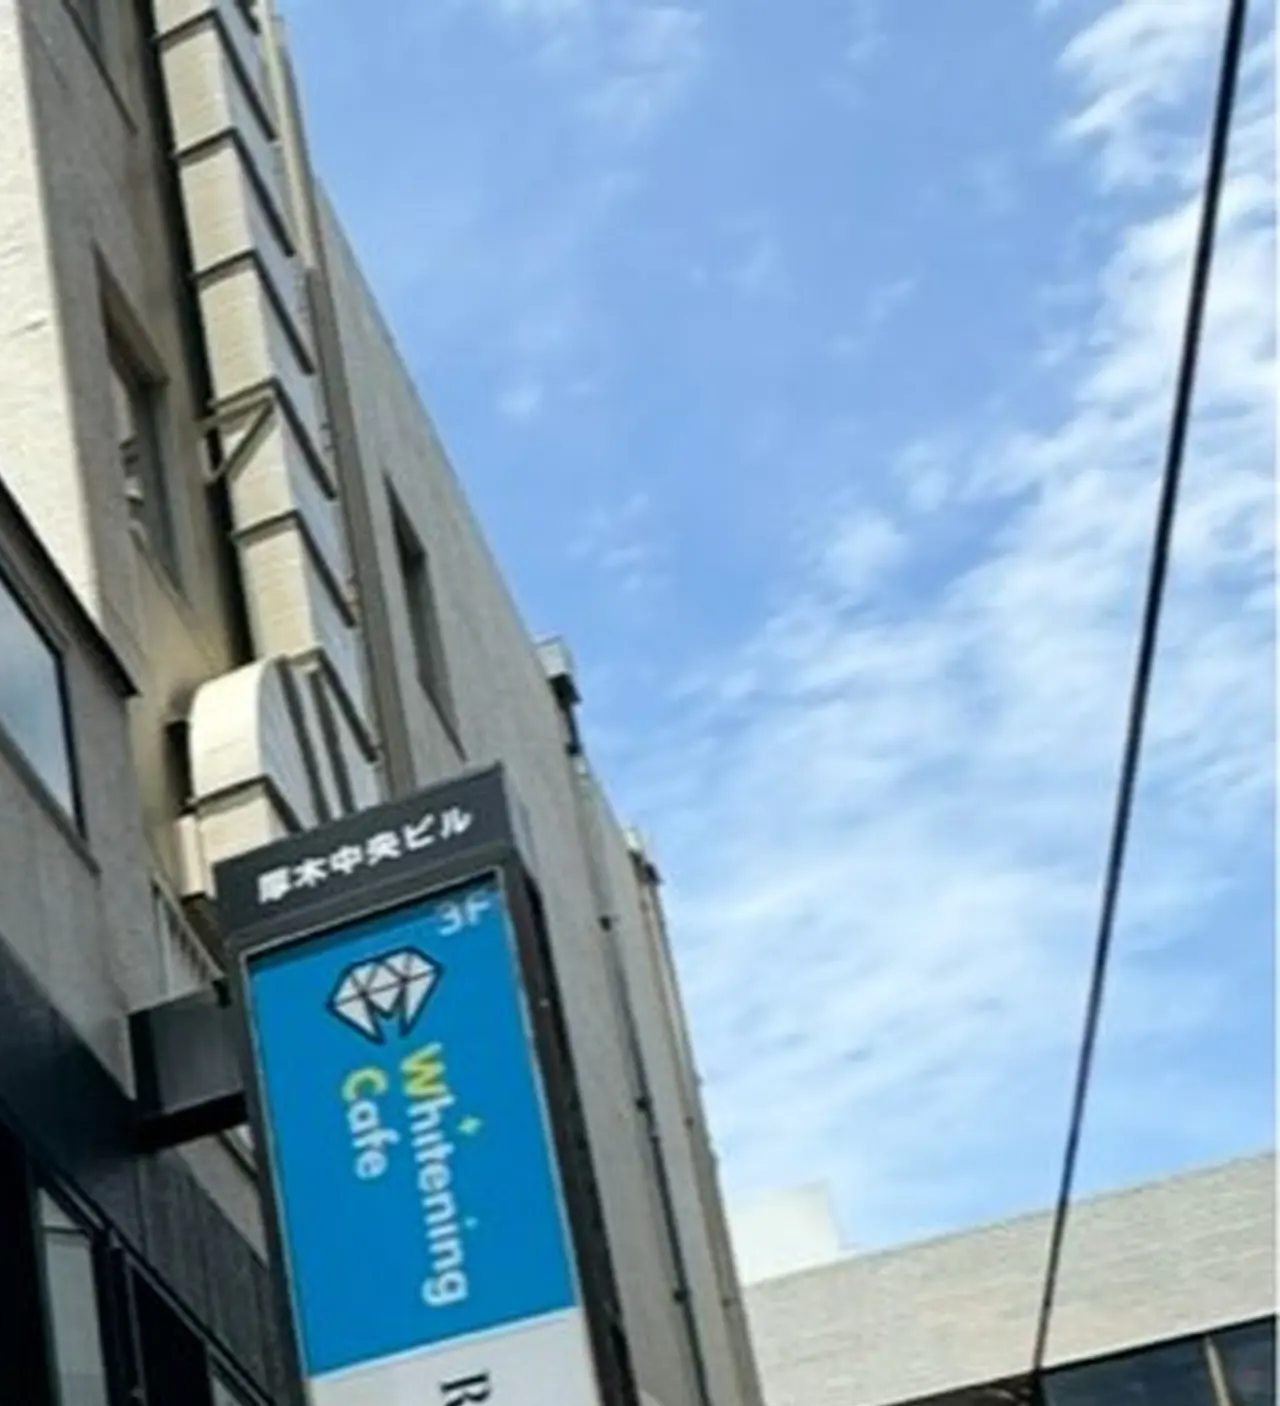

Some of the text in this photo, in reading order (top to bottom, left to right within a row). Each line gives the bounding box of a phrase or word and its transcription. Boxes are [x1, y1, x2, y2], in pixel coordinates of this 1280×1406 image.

[256, 806, 474, 905] 厚木中央ビル
[436, 895, 492, 936] 3F
[343, 1068, 400, 1181] Cafe
[400, 1042, 470, 1308] Whitening
